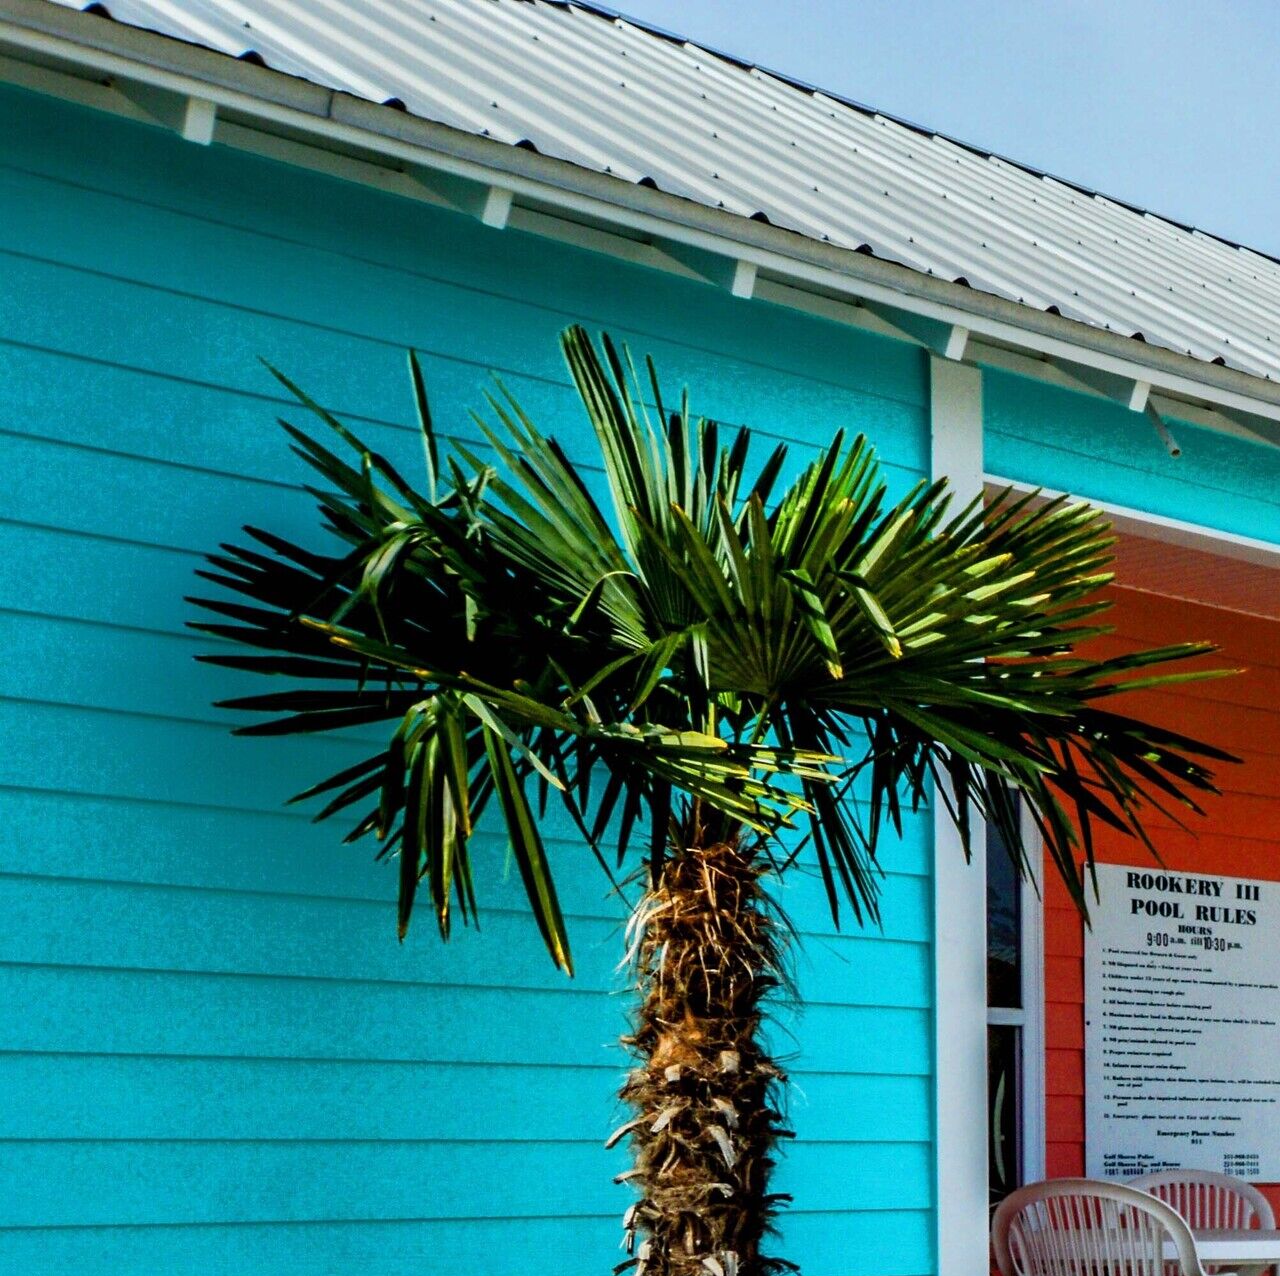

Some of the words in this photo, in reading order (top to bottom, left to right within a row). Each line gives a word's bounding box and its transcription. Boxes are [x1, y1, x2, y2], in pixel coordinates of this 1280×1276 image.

[1127, 872, 1223, 896] ROOKERY
[1236, 884, 1260, 901] III
[1131, 899, 1184, 919] POOL
[1196, 905, 1256, 925] RULES
[1178, 925, 1212, 935] HOURS
[1147, 933, 1168, 947] 9:00
[1204, 937, 1225, 951] 10:30
